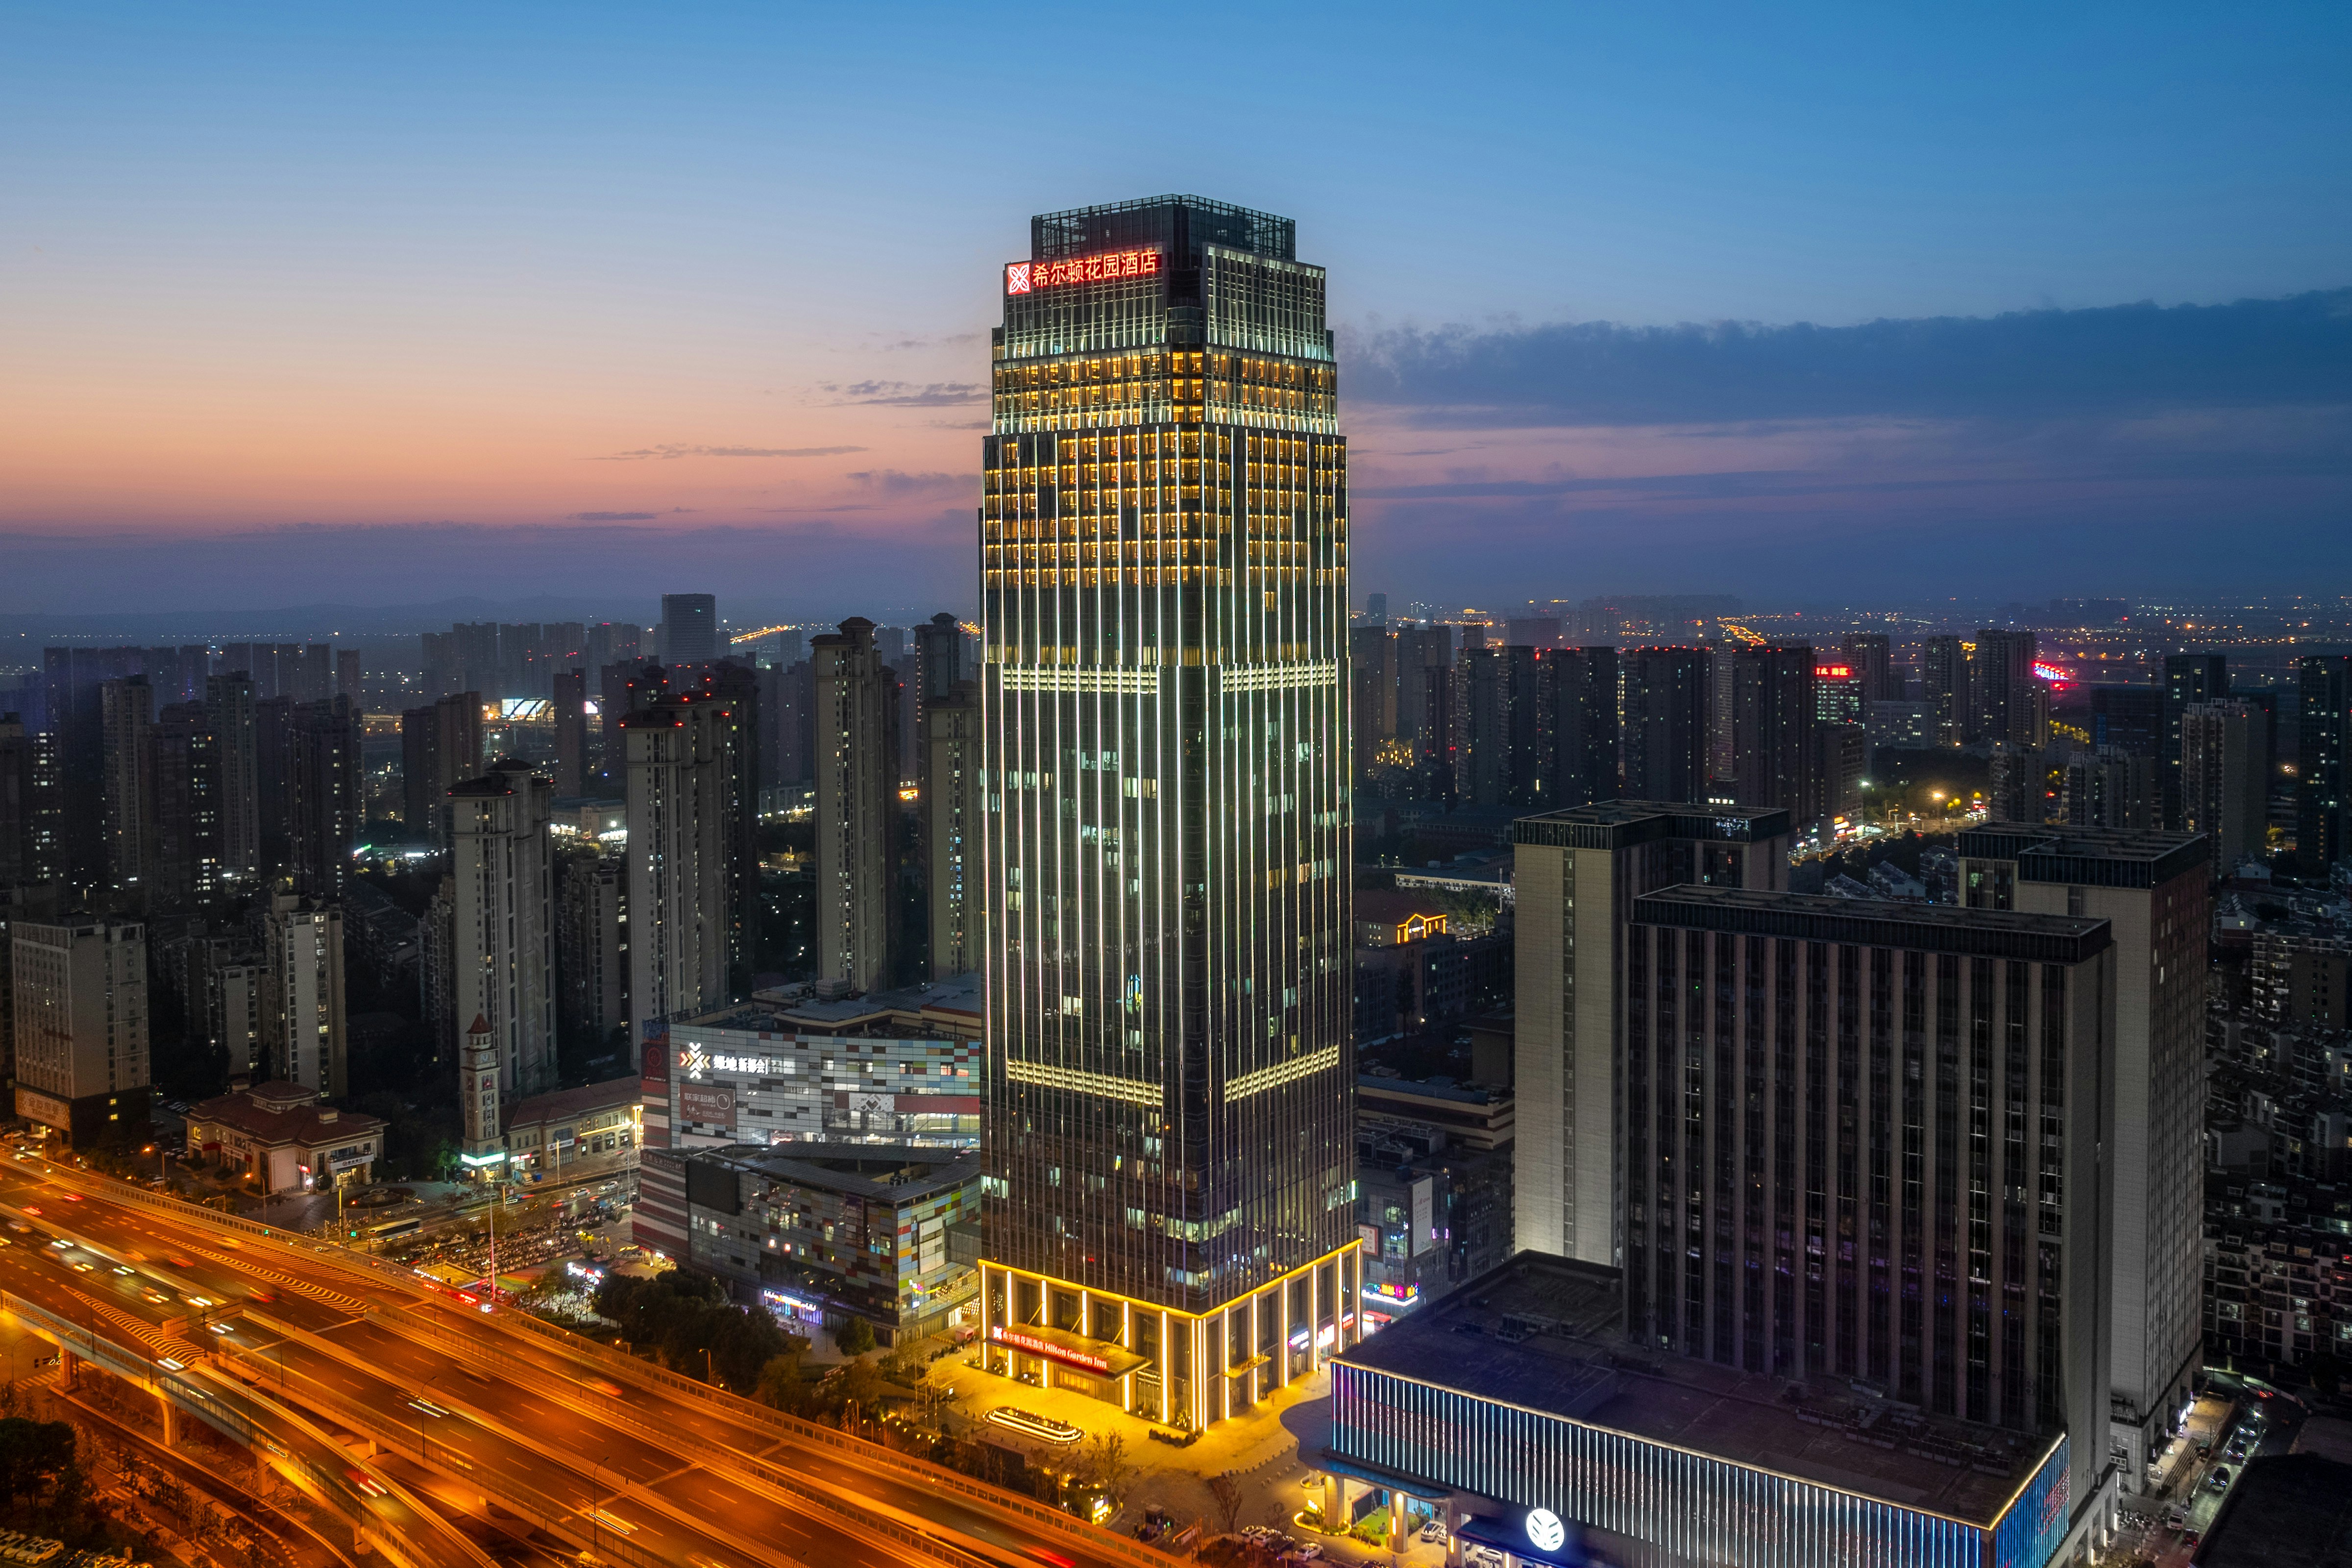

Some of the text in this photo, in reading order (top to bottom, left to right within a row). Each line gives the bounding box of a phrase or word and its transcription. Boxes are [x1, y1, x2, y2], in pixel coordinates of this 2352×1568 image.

[1032, 249, 1157, 287] 希尔顿花园酒店
[1045, 1343, 1107, 1369] Hilton Garden Inn
